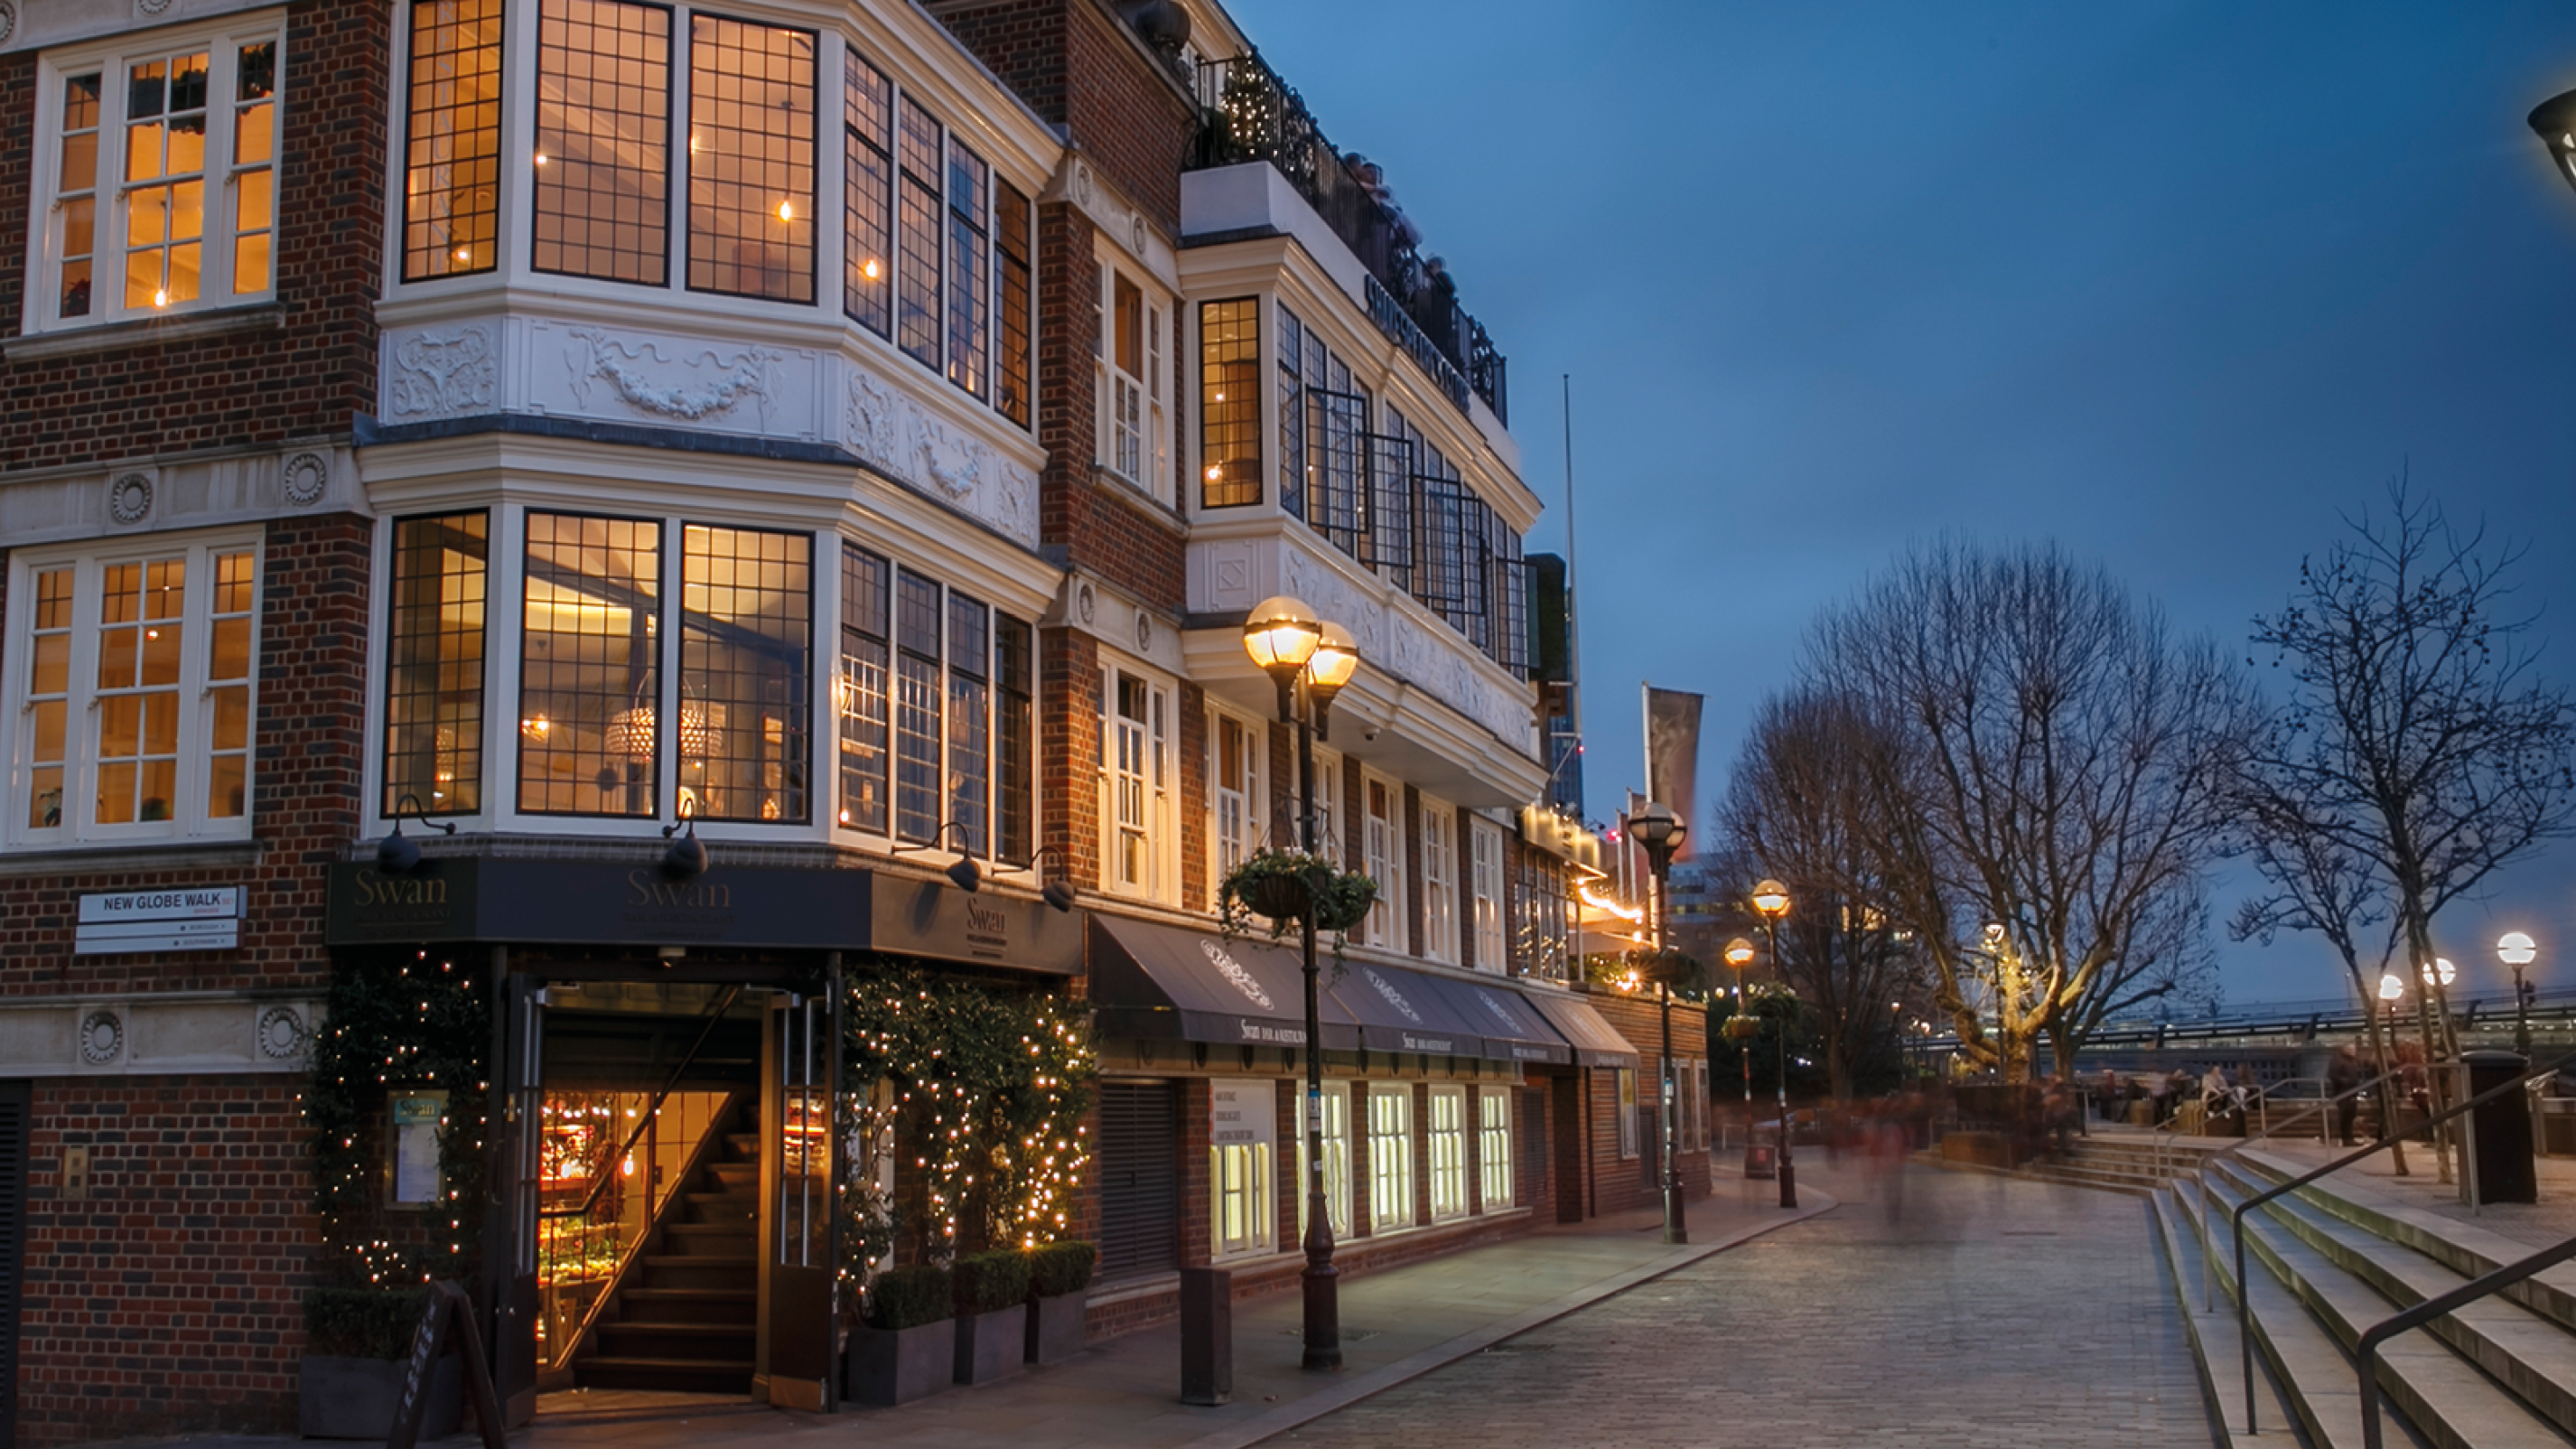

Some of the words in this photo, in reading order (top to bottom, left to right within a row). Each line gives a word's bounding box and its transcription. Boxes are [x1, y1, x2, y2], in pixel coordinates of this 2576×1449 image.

[432, 1, 455, 273] RESTAURANT
[104, 897, 135, 911] NEW
[136, 894, 182, 909] GLOBE
[185, 892, 221, 907] WALK
[354, 868, 447, 907] Swan
[627, 868, 732, 908] Swan
[966, 896, 1005, 933] Swan
[1241, 1018, 1260, 1040] Swan
